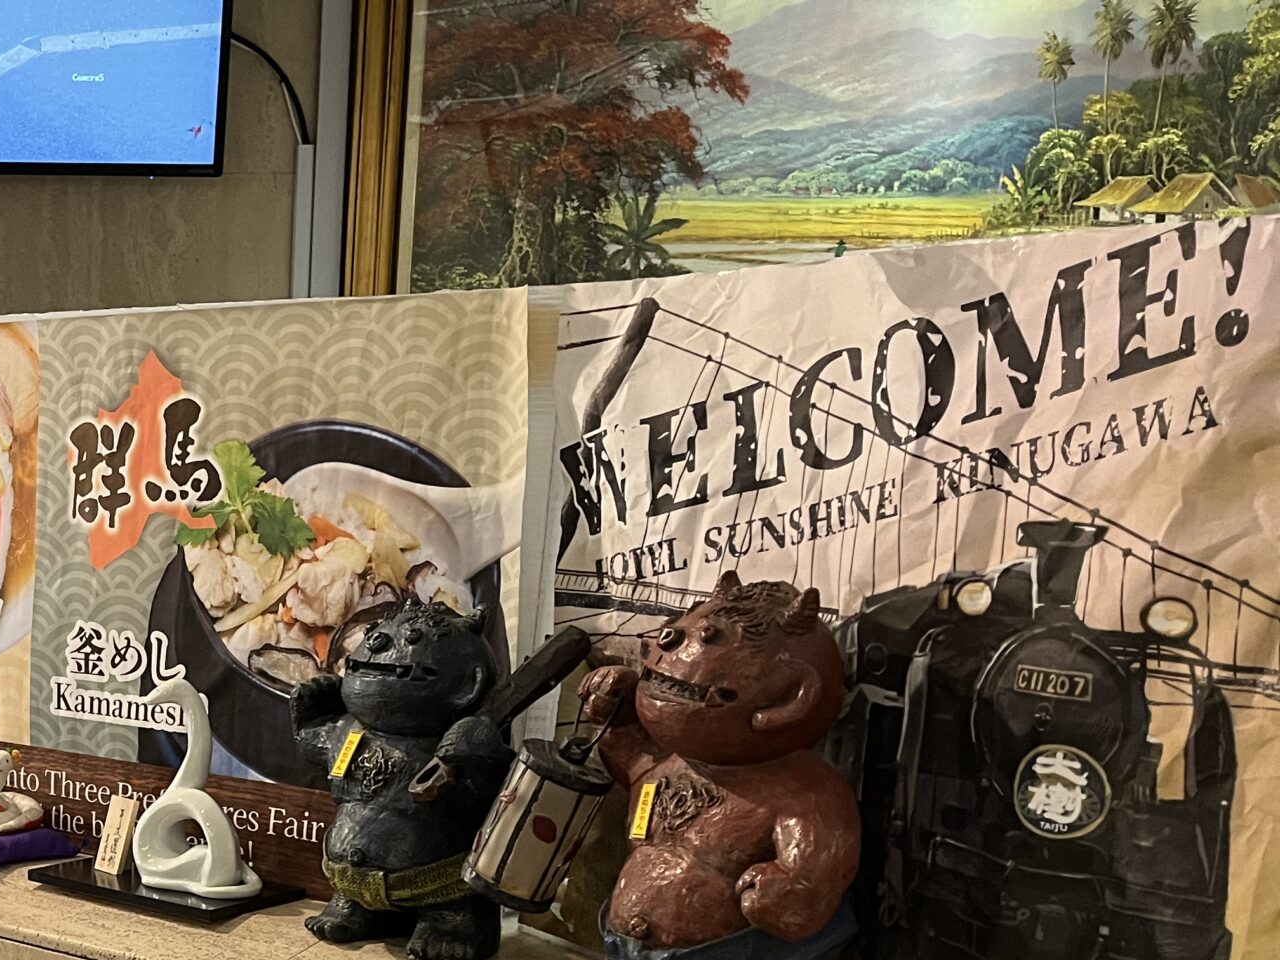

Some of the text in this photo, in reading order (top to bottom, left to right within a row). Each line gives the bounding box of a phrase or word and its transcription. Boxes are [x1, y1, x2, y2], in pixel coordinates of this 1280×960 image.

[560, 216, 1251, 537] WELCOME!
[70, 397, 223, 528] 群馬
[704, 477, 899, 564] SUNSHINE
[933, 385, 1222, 504] KINUGAWA
[70, 626, 182, 681] 釜めし
[45, 769, 111, 806] Three
[266, 807, 325, 843] Fair
[51, 804, 85, 835] the
[1039, 821, 1069, 833] TAIJU
